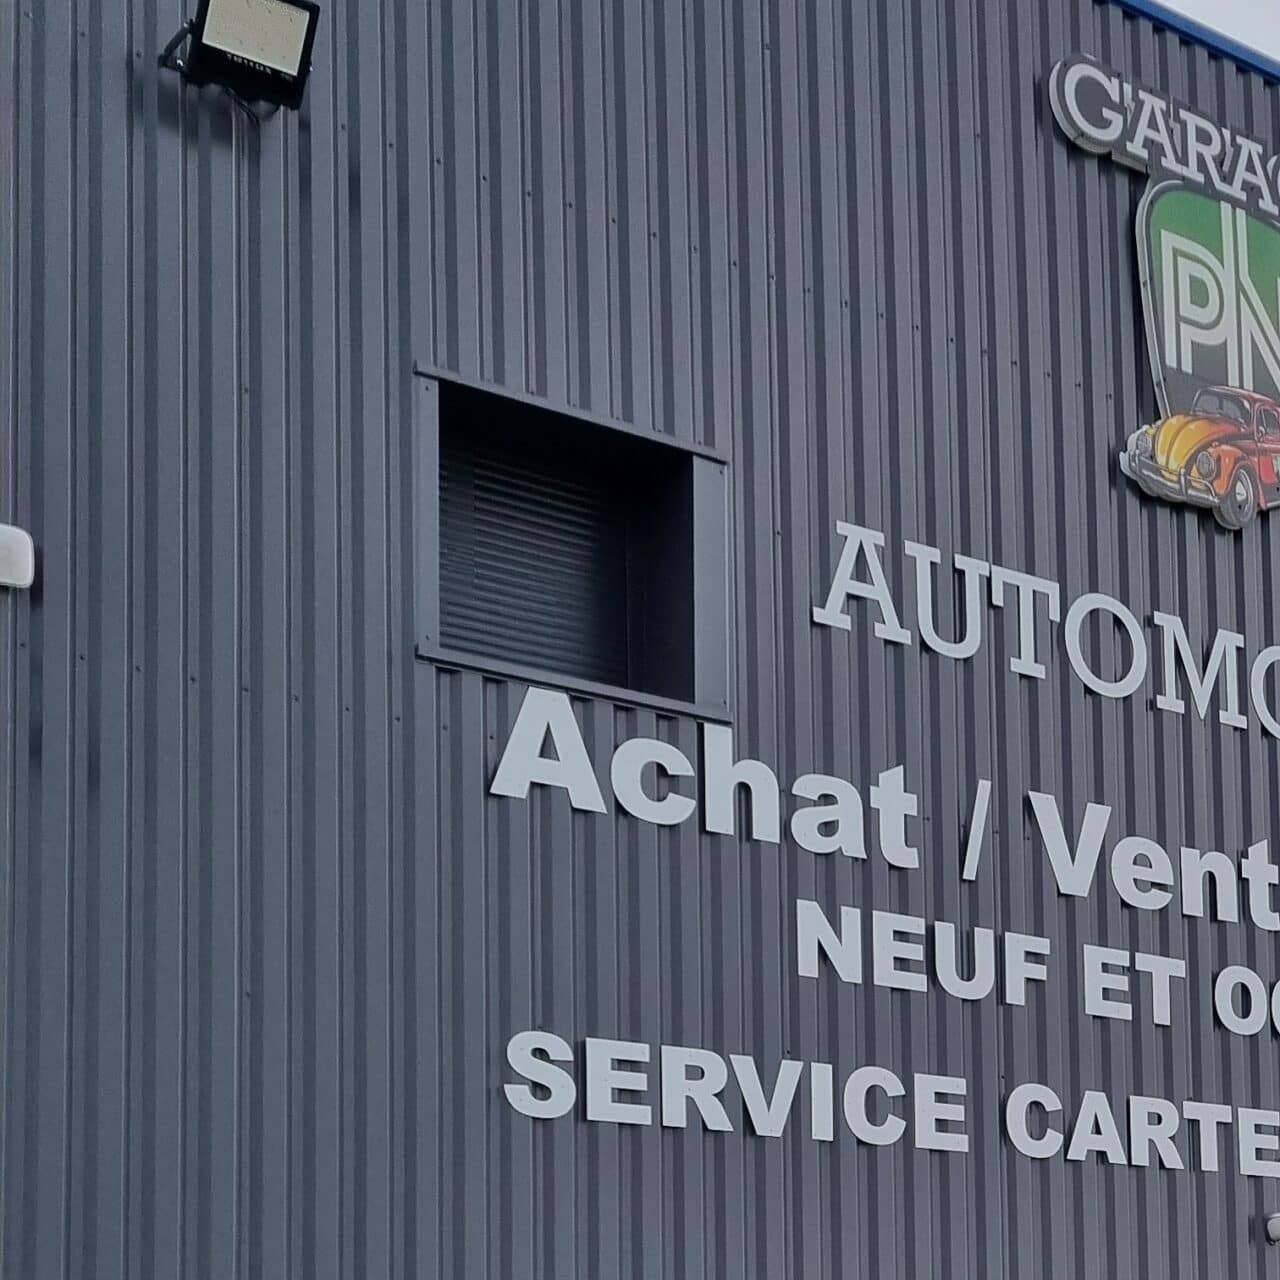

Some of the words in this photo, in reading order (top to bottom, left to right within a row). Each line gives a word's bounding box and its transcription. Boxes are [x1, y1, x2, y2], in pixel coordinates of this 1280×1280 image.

[490, 686, 919, 869] Achat
[963, 780, 991, 881] /
[796, 899, 1051, 1006] NEUF
[1083, 943, 1186, 1026] ET
[504, 1031, 969, 1153] SERVICE
